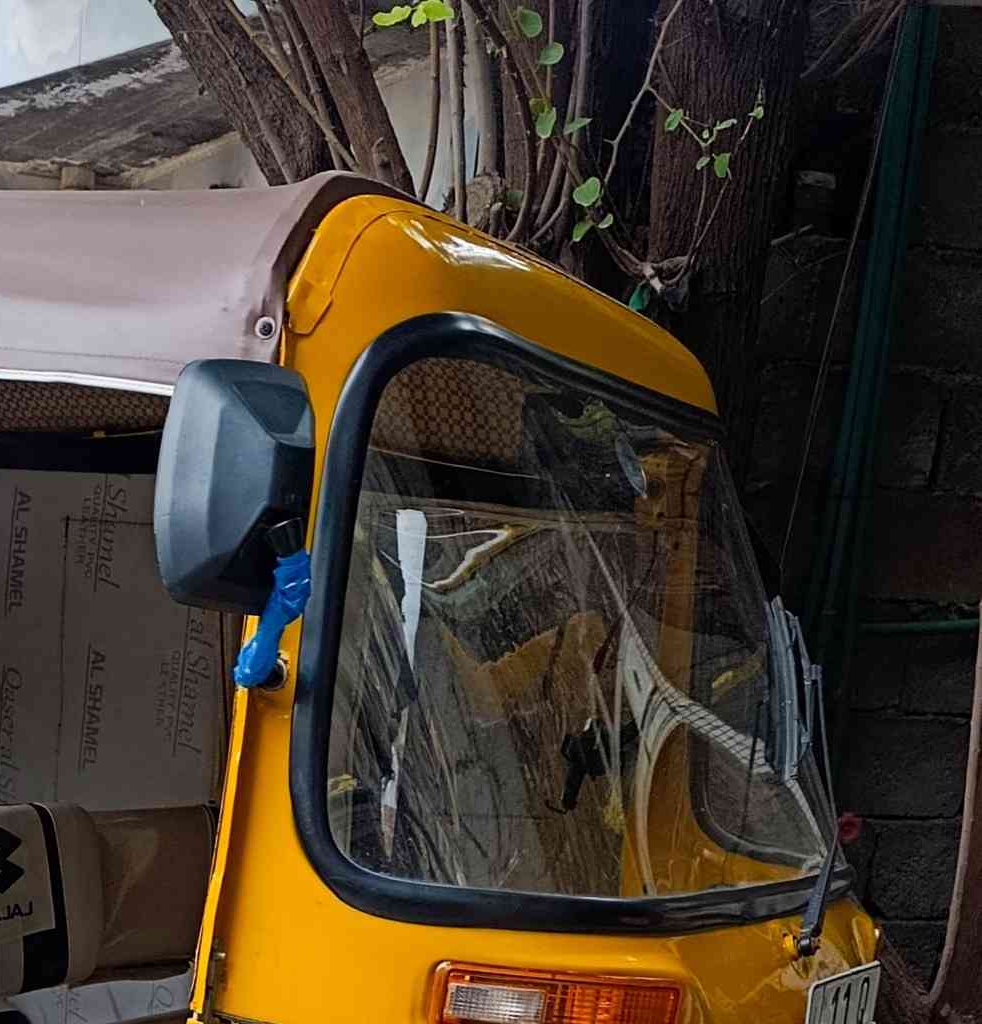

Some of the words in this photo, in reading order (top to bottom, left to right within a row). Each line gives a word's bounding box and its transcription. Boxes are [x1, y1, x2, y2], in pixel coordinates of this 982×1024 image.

[15, 490, 32, 521] AL
[8, 526, 29, 612] SHAMEL
[89, 651, 106, 677] AL
[178, 651, 211, 753] Shamel
[82, 682, 104, 769] SHAMEL
